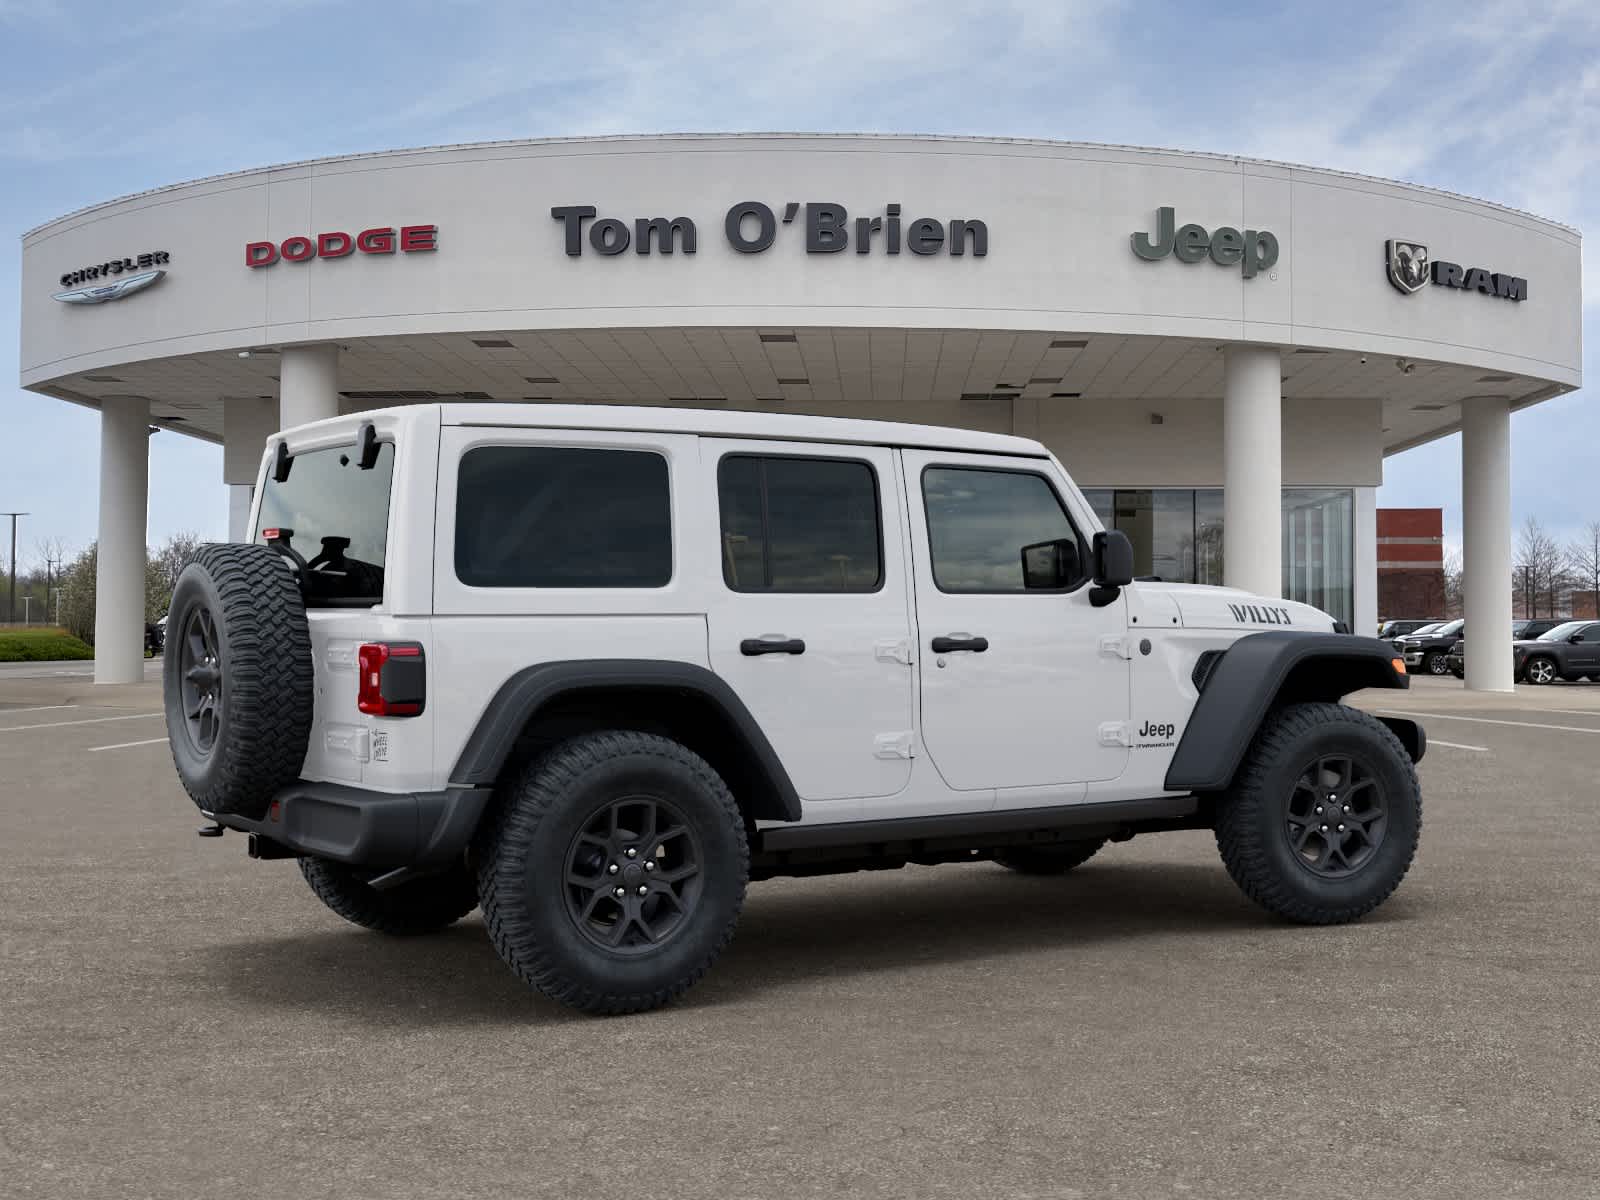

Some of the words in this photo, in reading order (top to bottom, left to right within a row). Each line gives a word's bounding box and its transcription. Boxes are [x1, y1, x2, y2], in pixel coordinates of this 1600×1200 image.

[246, 225, 438, 269] DODGE
[551, 205, 697, 256] Tom
[725, 201, 988, 257] O'Brien
[1130, 207, 1279, 279] Jeep
[60, 251, 169, 286] CHRYSLER
[1431, 261, 1527, 301] RAM
[1227, 603, 1292, 624] WILLYS
[1139, 720, 1175, 739] Jeep
